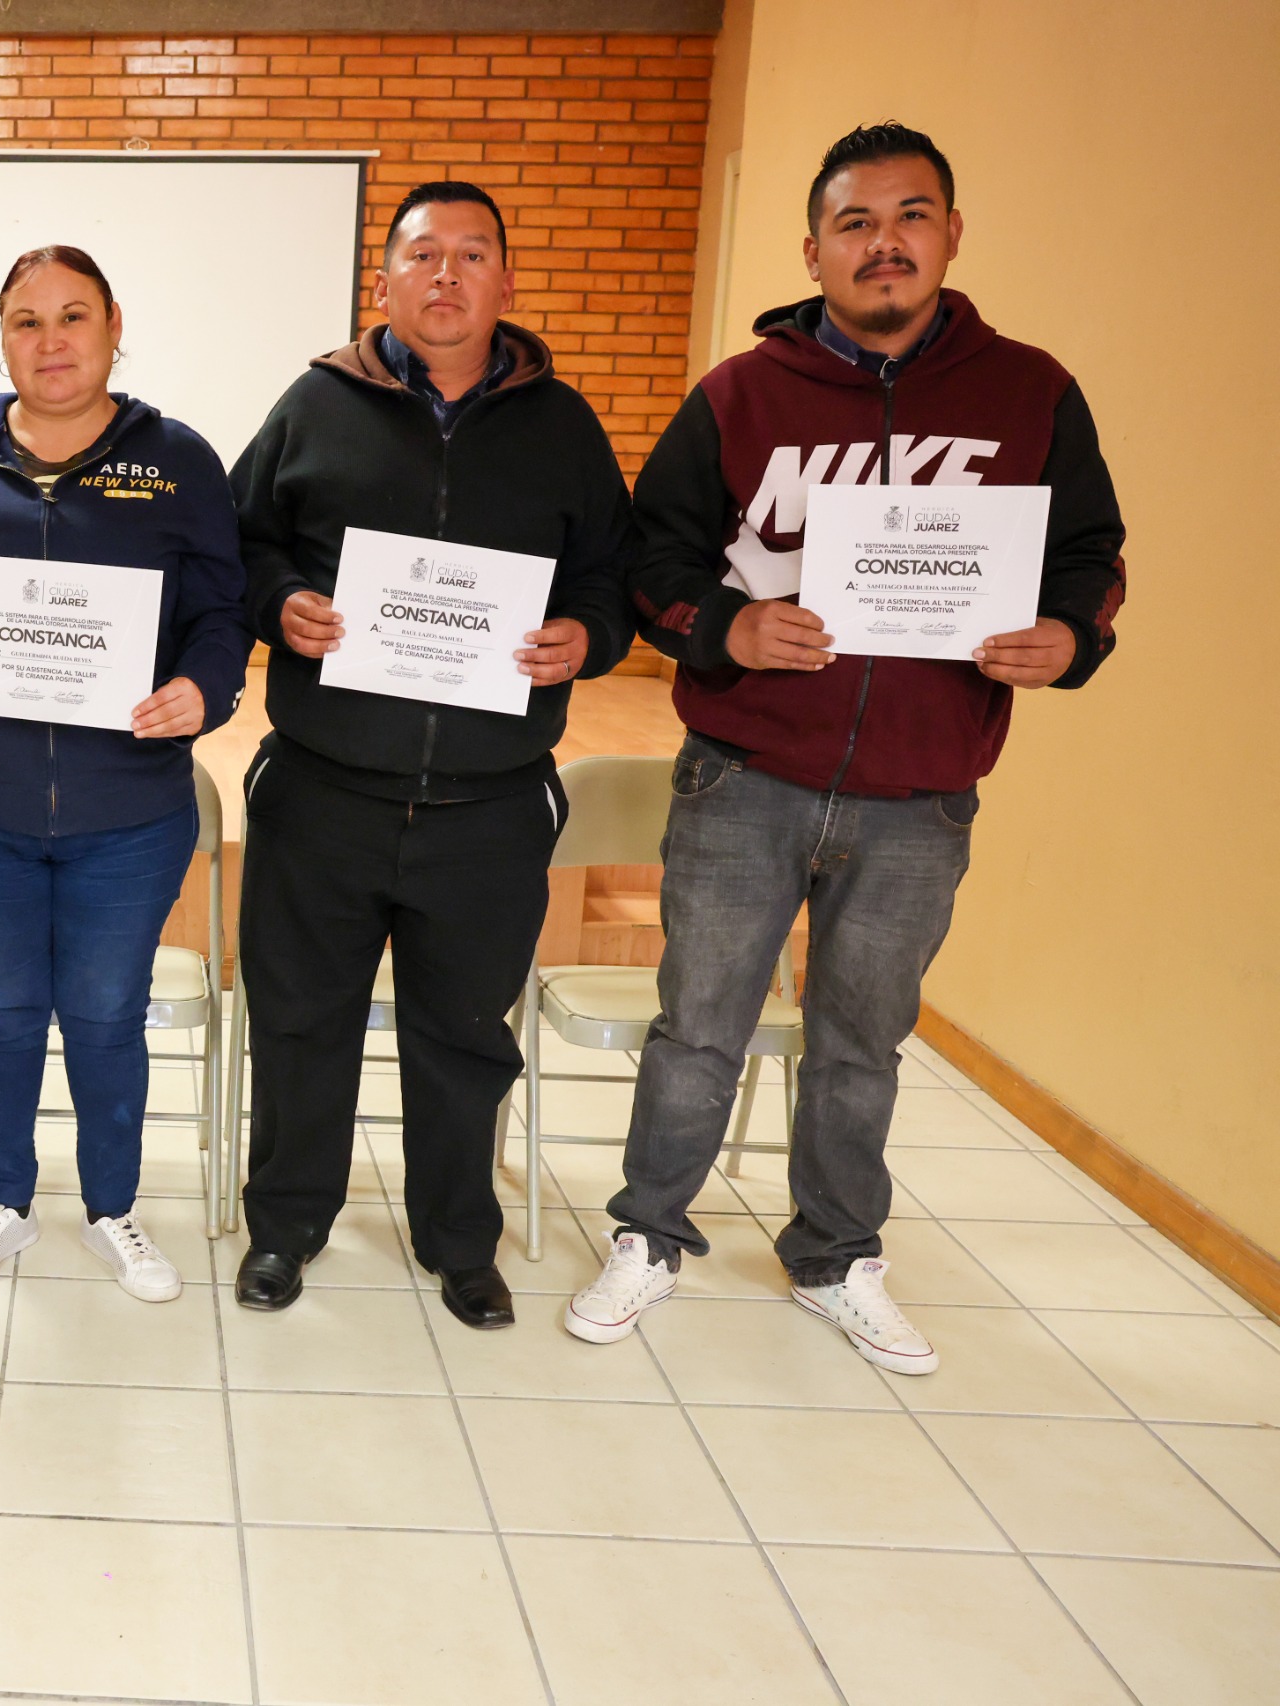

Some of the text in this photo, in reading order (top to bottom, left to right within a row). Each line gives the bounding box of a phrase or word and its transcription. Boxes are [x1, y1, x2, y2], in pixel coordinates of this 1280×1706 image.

[100, 463, 160, 477] AERO
[79, 476, 178, 494] NEW YORK
[915, 513, 960, 522] CIUDAD
[914, 520, 959, 532] JUÁREZ
[438, 567, 477, 580] CIUDAD
[855, 559, 982, 576] CONSTANCIA
[436, 576, 475, 589] JUÁREZ
[846, 582, 858, 590] A:
[49, 587, 88, 598] CIUDAD
[49, 596, 87, 607] JUÁREZ
[436, 596, 472, 606] DESARROLLO
[381, 604, 490, 632] CONSTANCIA
[370, 624, 381, 632] A:
[405, 651, 433, 659] CRIANZA
[435, 655, 463, 664] POSITIVA
[406, 644, 443, 654] ASISTENCIA
[456, 651, 478, 659] TALLER
[26, 666, 62, 674] ASISTENCIA
[56, 676, 83, 684] POSITIVA
